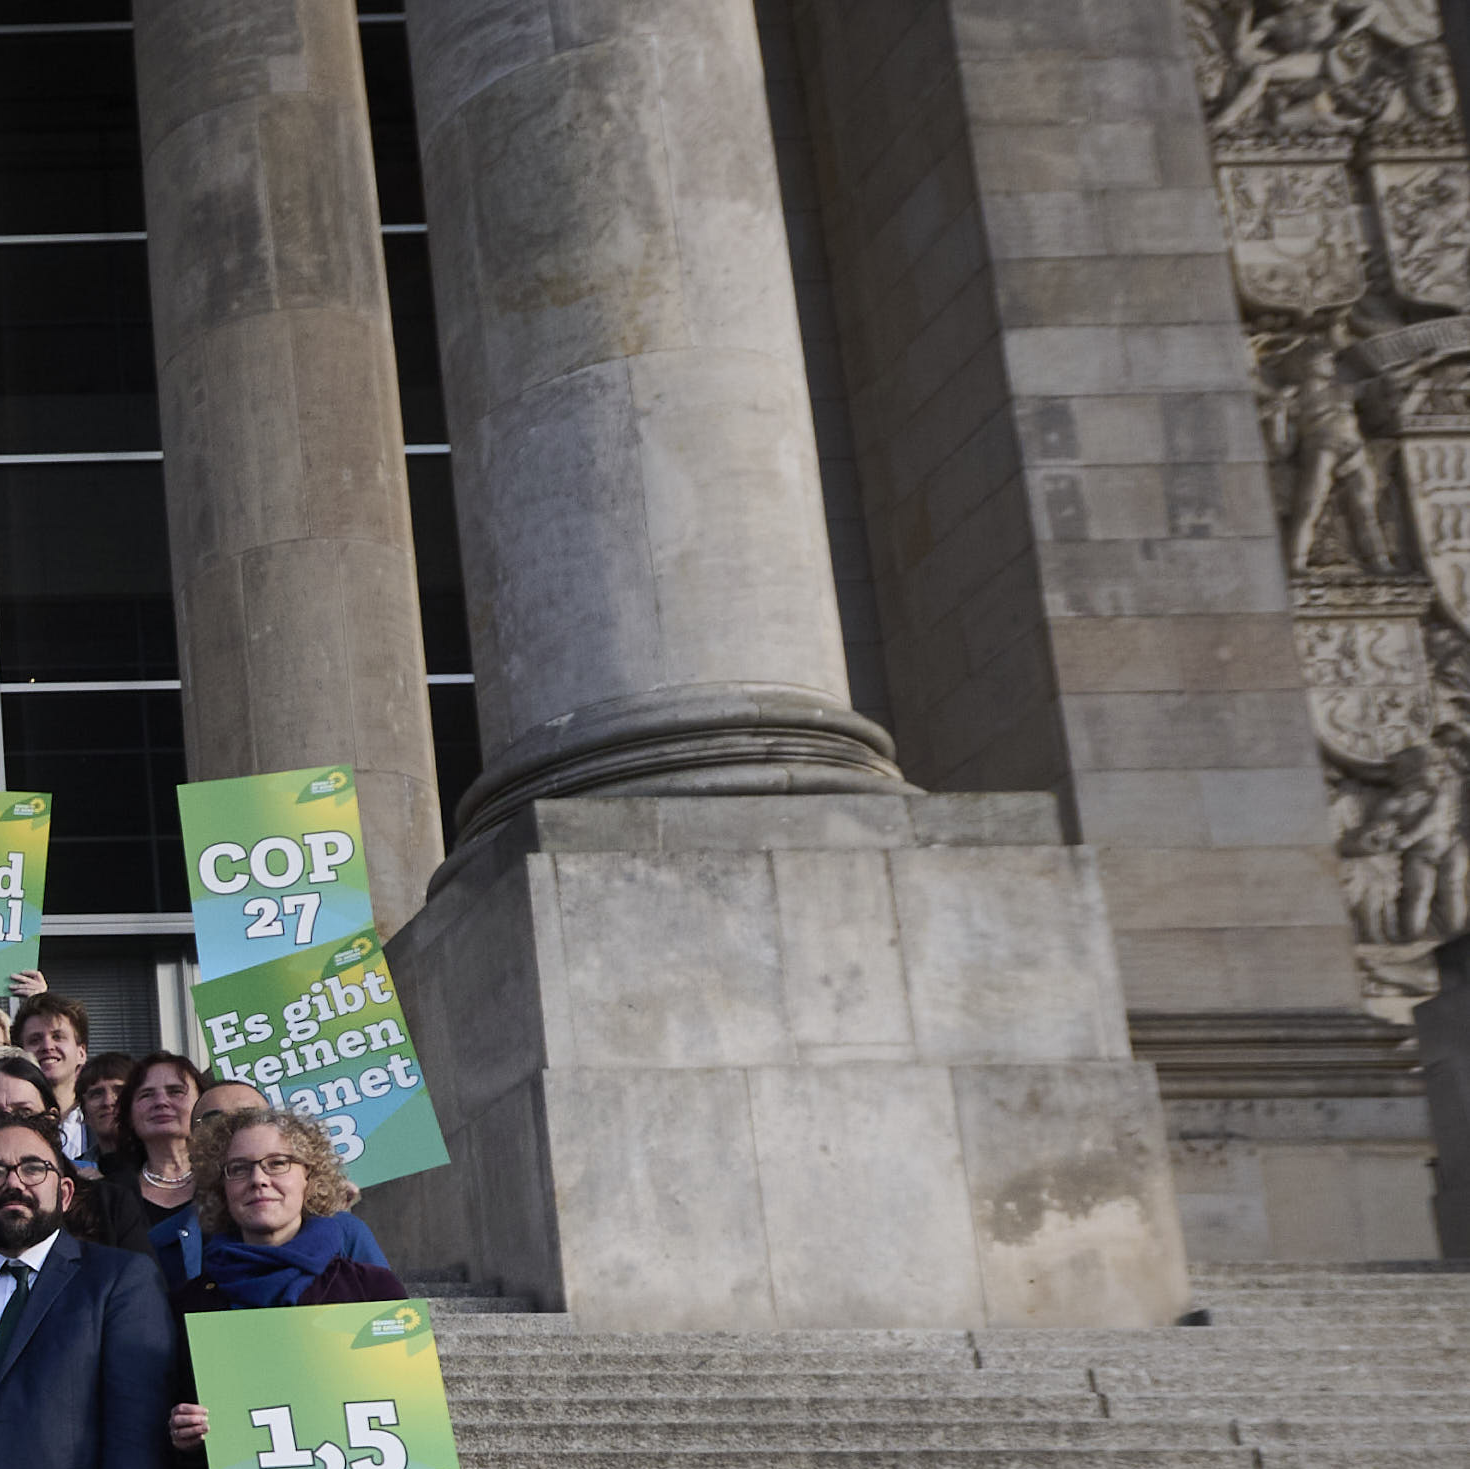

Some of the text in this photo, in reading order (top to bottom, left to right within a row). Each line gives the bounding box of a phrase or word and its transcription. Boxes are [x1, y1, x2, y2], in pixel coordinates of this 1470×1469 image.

[197, 830, 355, 895] COP
[242, 891, 322, 945] 27
[204, 970, 394, 1056] Es gibt
[214, 1018, 405, 1089] keinen
[263, 1053, 419, 1117] lanet
